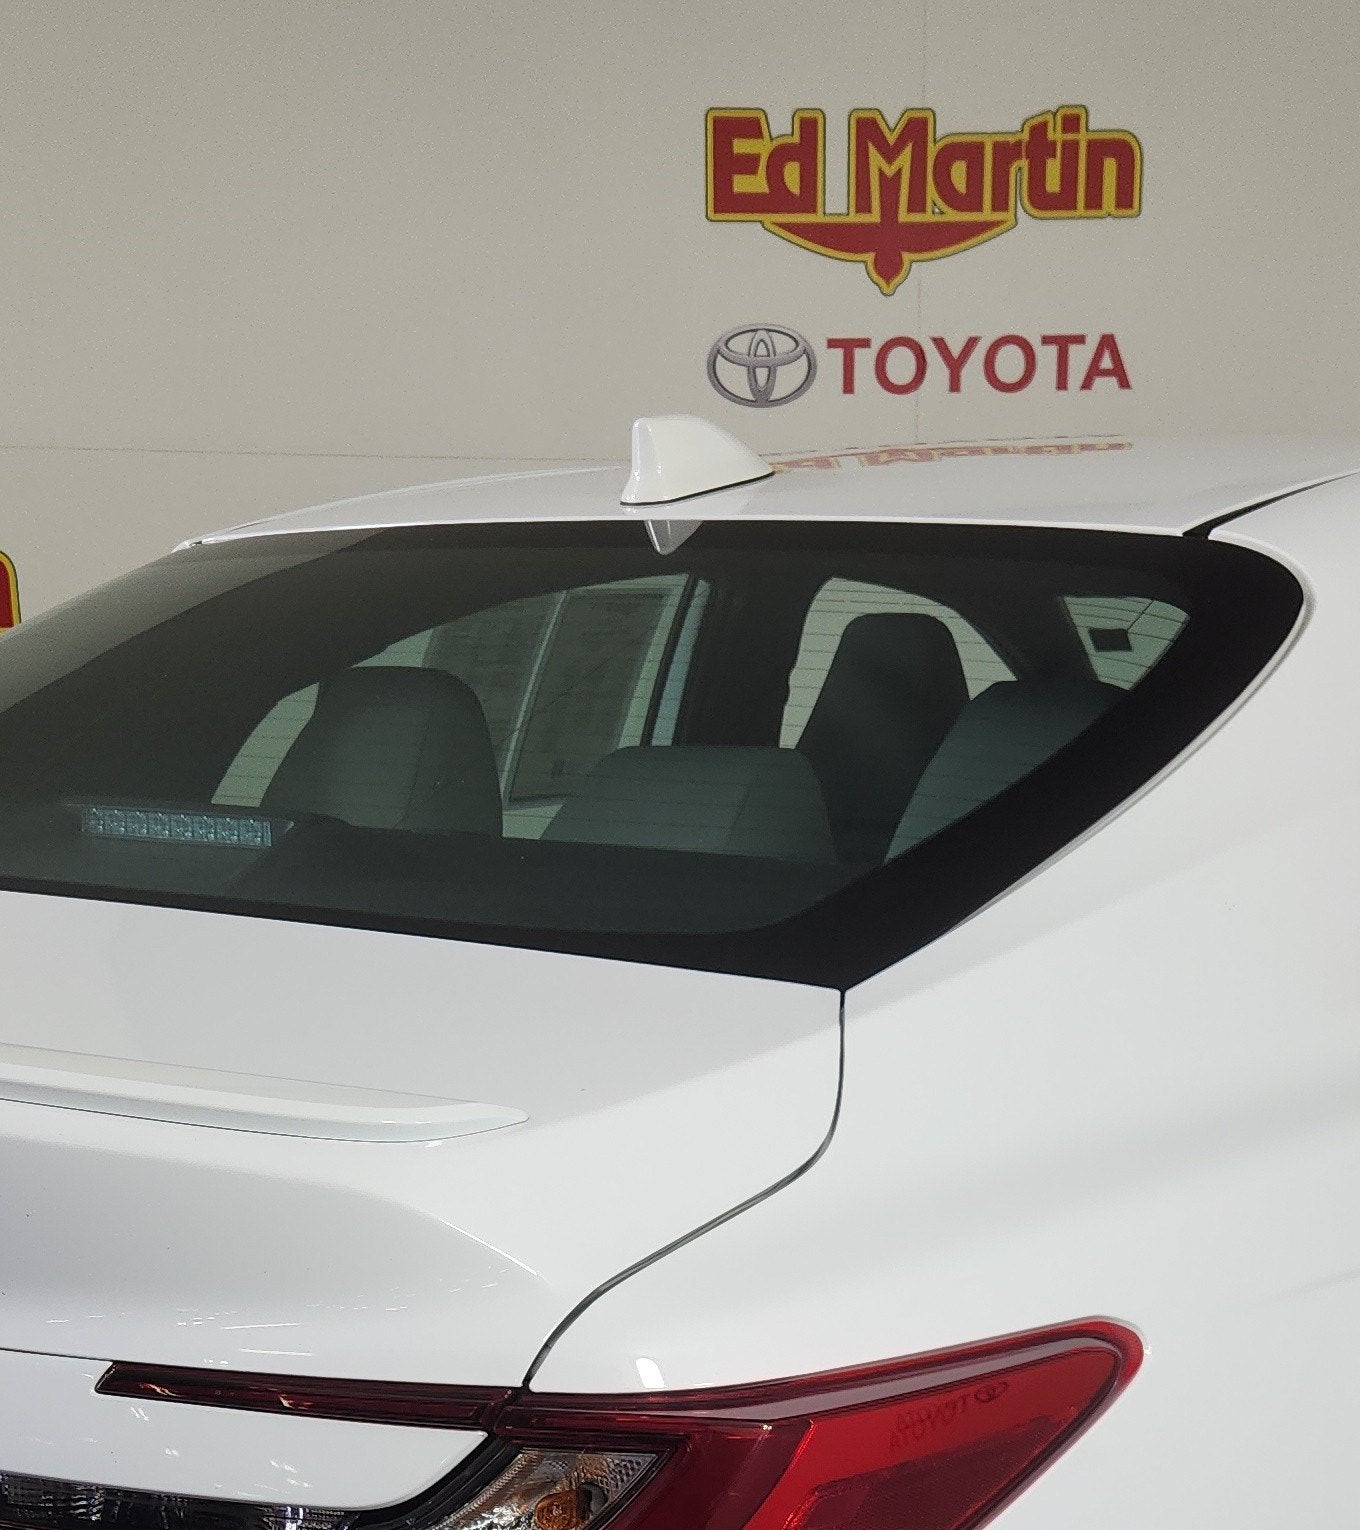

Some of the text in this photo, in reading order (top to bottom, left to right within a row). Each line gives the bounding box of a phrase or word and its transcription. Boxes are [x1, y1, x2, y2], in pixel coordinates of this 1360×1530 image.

[707, 106, 1142, 220] Ed Martin
[827, 333, 1133, 395] TOYOTA
